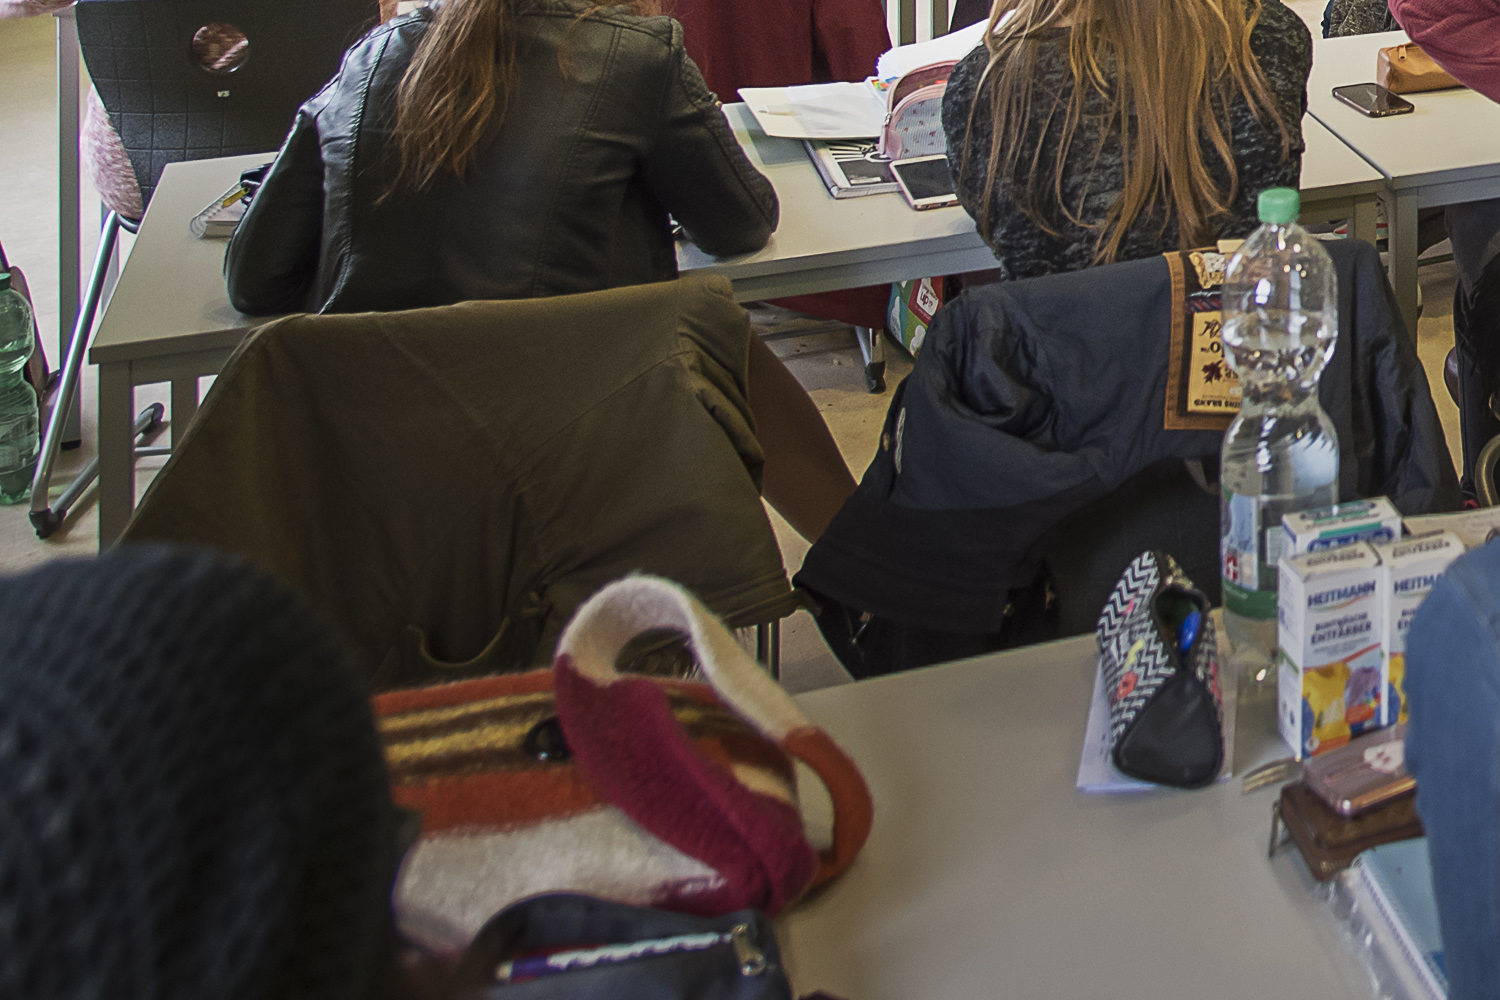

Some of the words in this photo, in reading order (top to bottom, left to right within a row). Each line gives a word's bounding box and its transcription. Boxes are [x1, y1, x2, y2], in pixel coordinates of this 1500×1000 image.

[1307, 579, 1376, 608] HEITMANN
[1310, 620, 1372, 646] ENTFÄRBER
[1315, 612, 1368, 631] BUNTWÄSCHE
